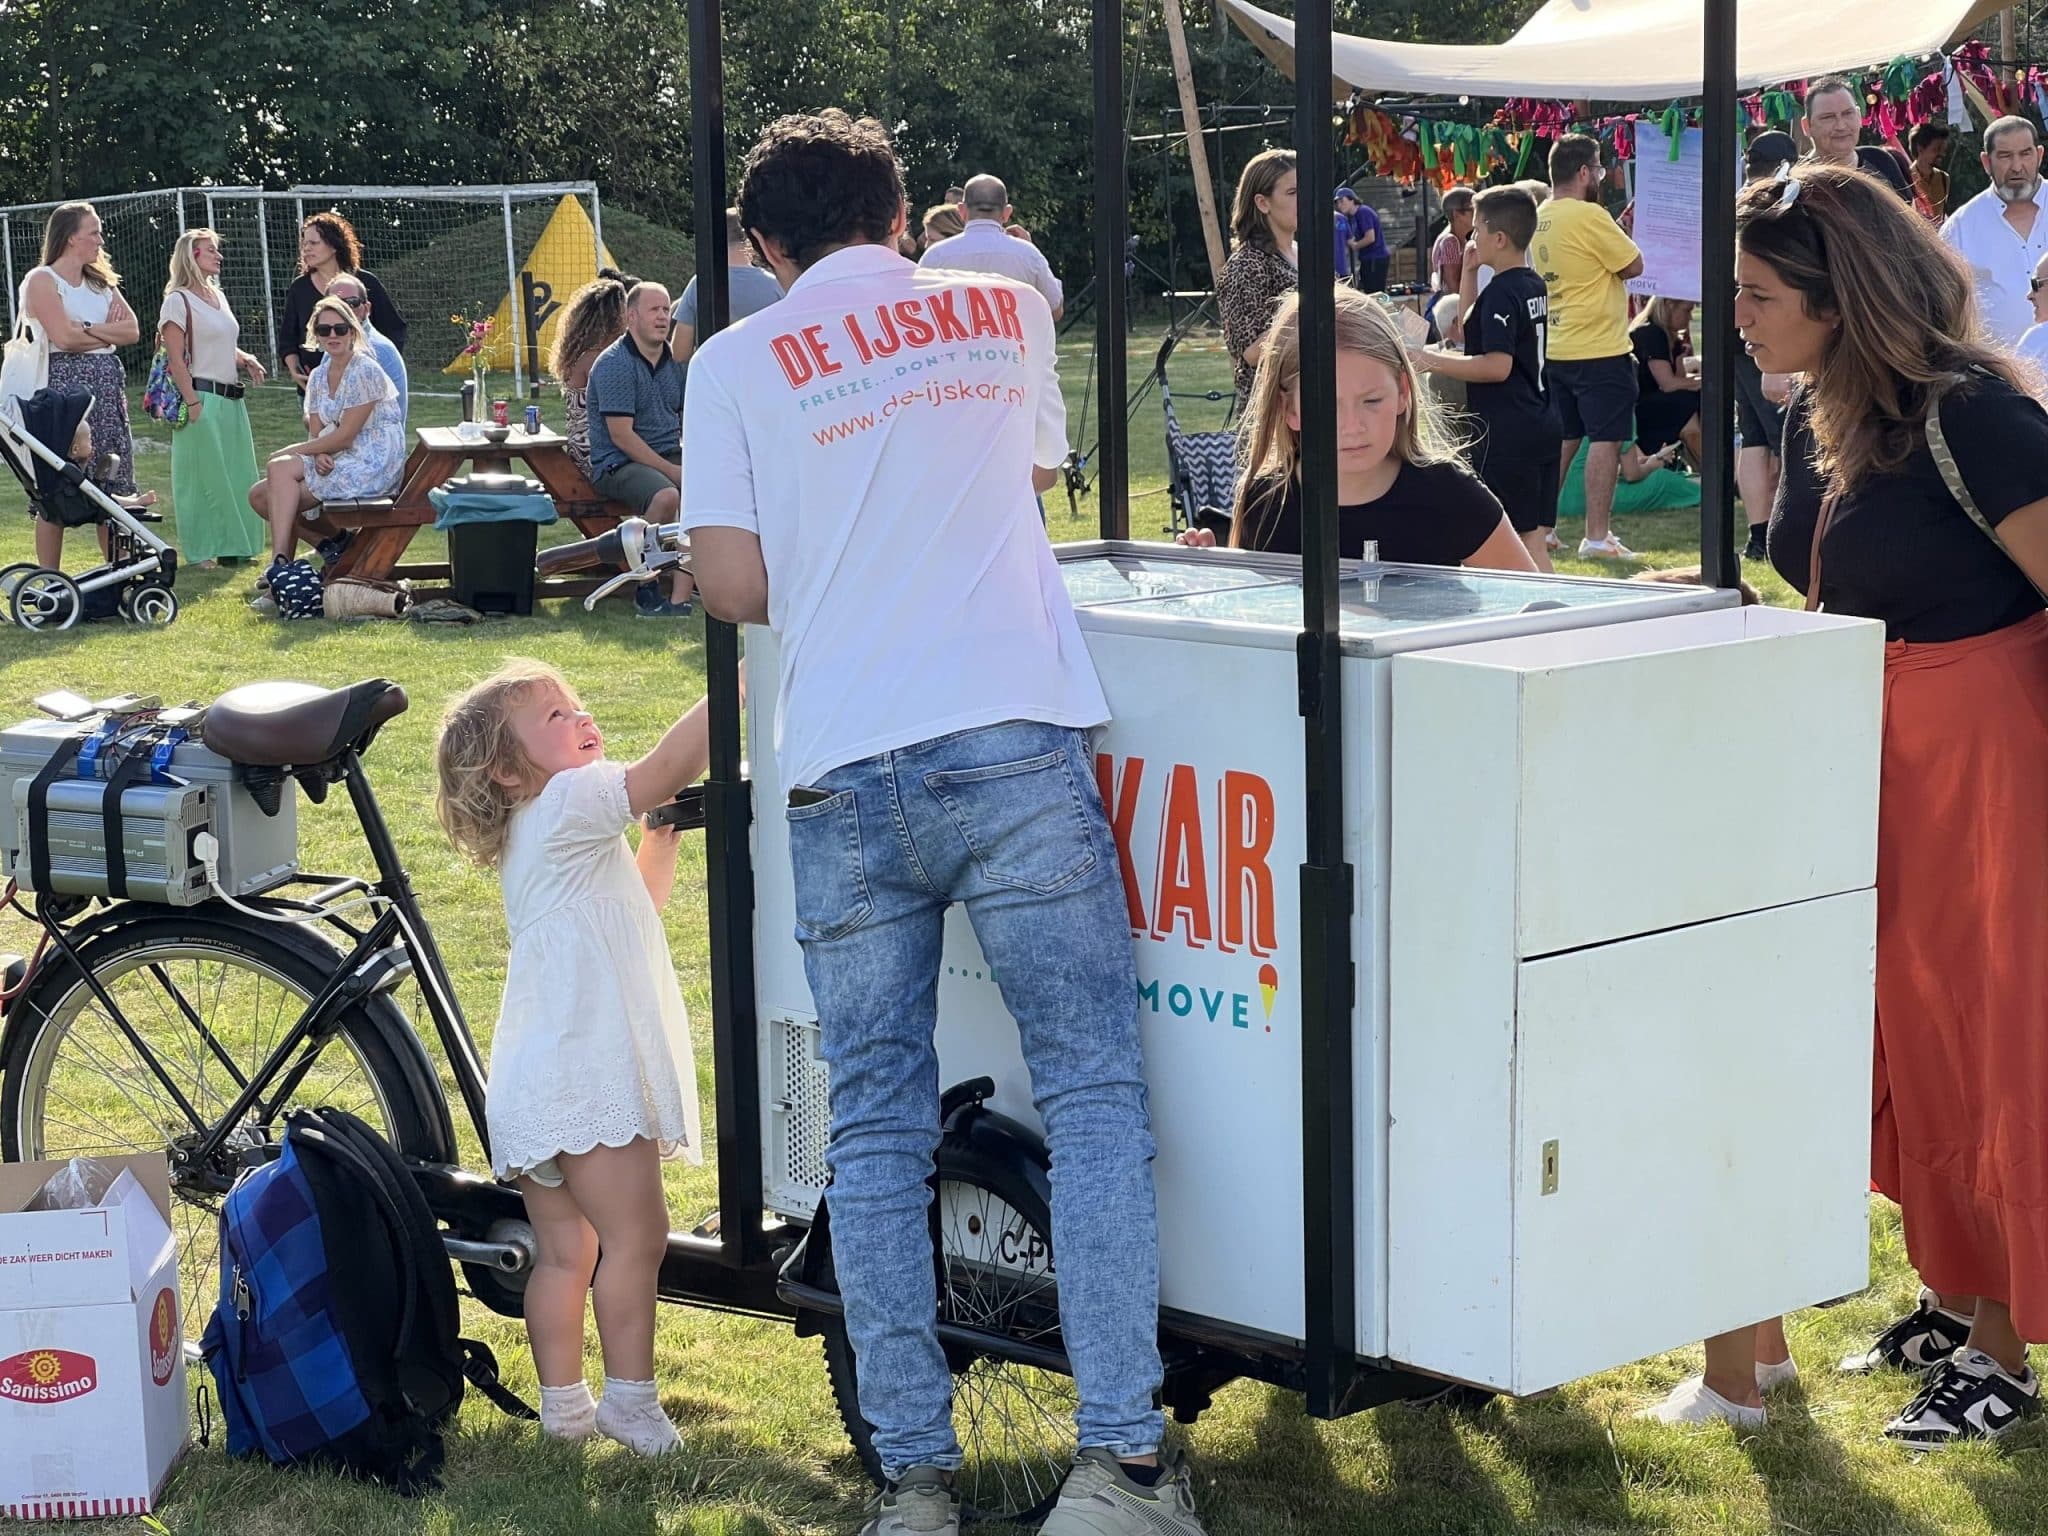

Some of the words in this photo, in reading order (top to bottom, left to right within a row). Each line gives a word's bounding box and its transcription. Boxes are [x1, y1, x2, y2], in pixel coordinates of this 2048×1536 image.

[770, 324, 843, 391] DE
[842, 286, 1025, 367] IJSKAR
[812, 378, 1025, 447] www.de-ijskar.nl
[10, 1255, 27, 1264] ZAK
[28, 1253, 54, 1263] WEER
[55, 1251, 80, 1261] DICHT
[82, 1249, 113, 1259] MAKEN
[0, 1376, 92, 1400] Sanissimo
